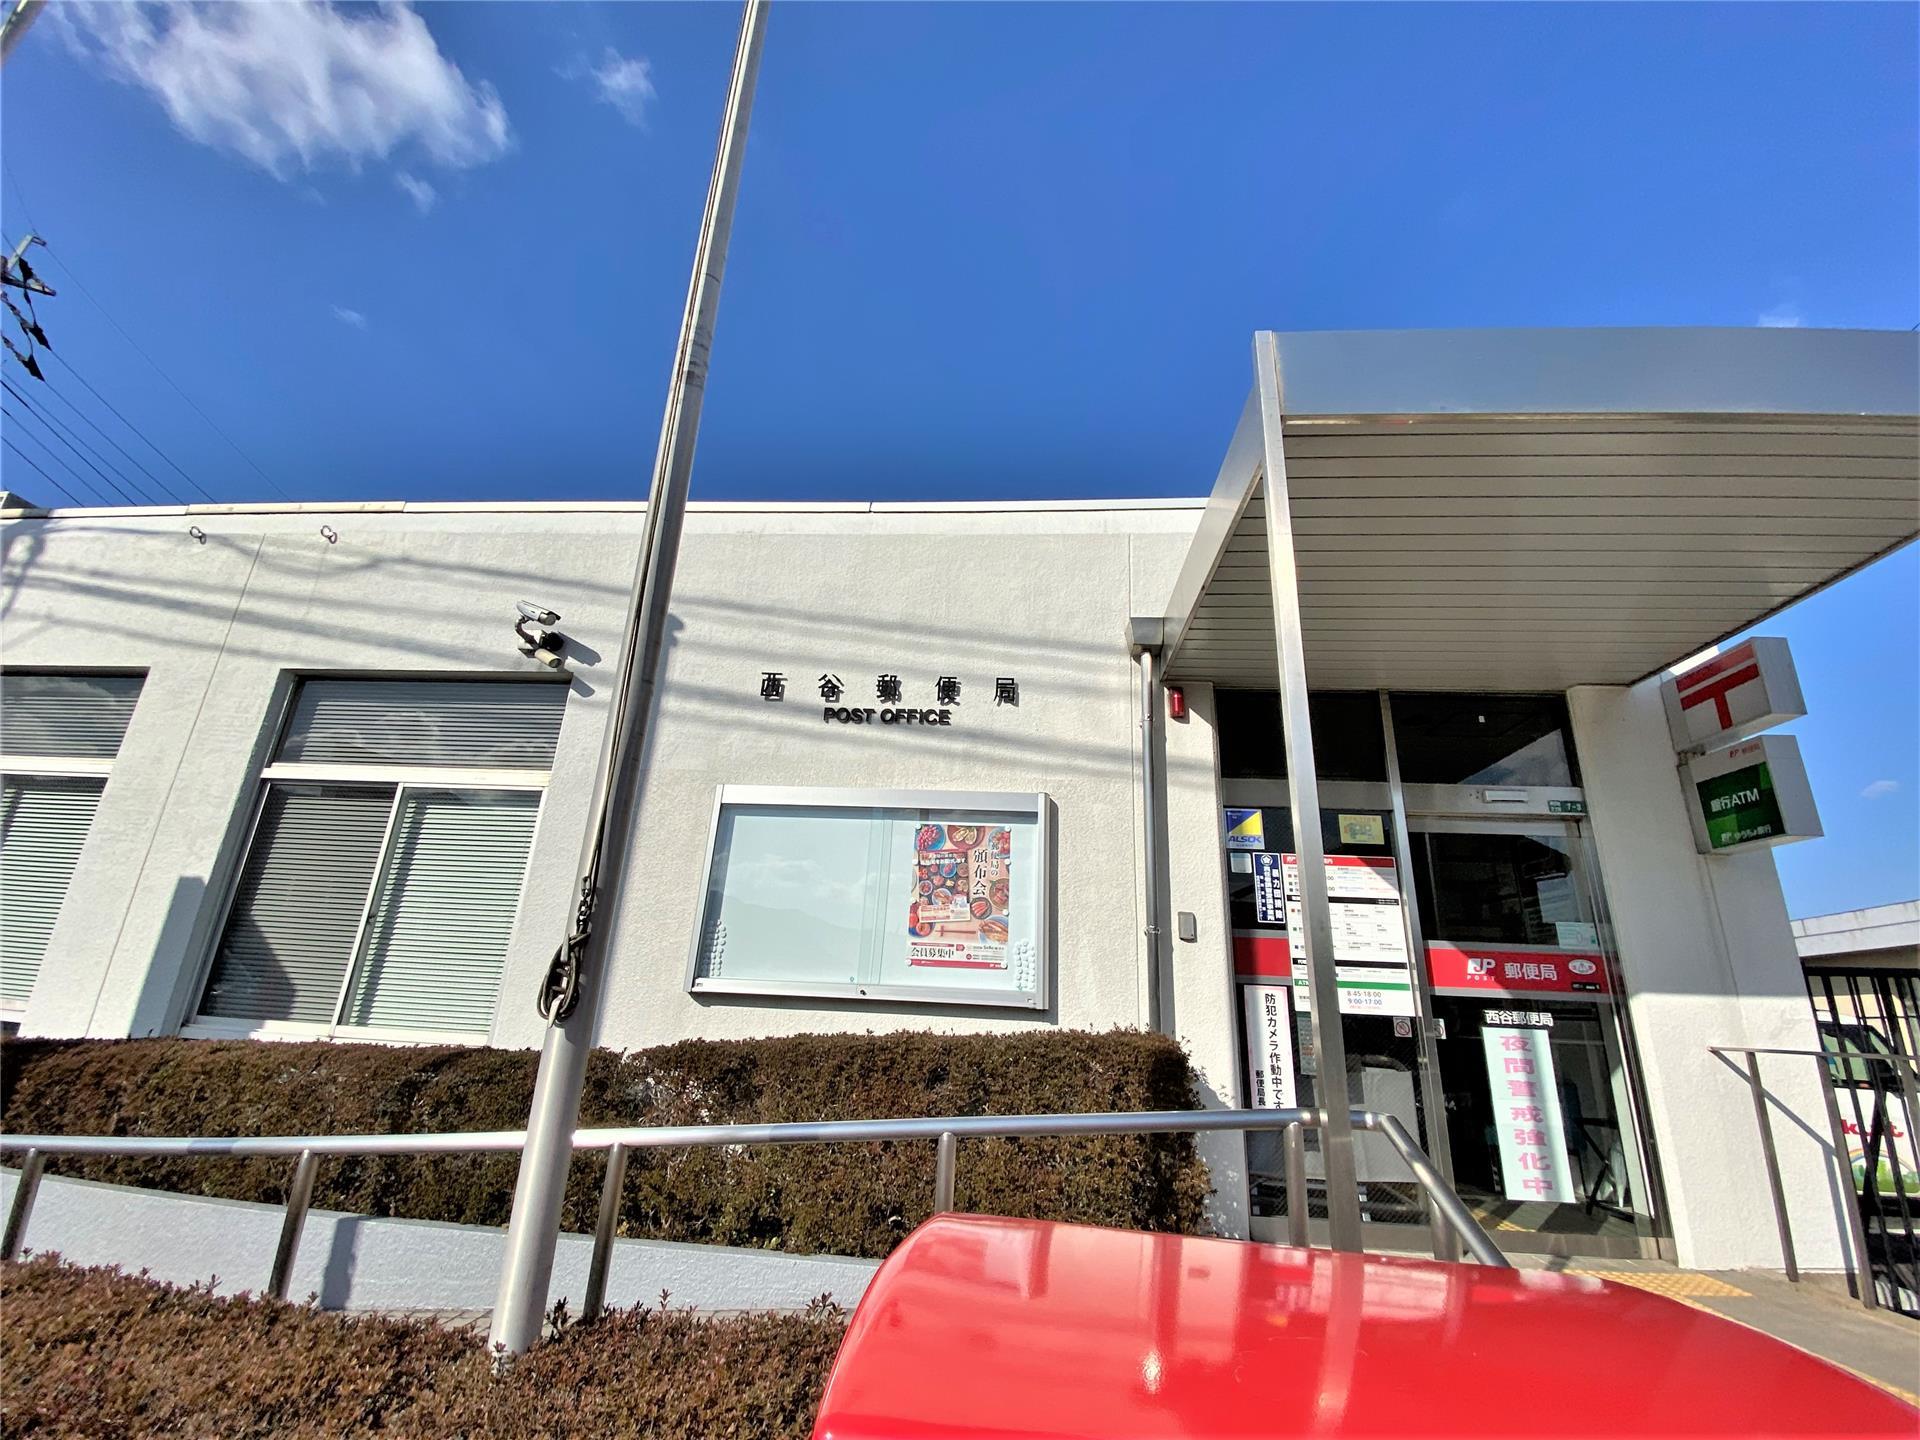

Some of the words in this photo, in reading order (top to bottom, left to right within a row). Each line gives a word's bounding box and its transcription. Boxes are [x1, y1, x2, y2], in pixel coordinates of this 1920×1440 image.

[760, 672, 1017, 705] 西谷郵便局
[823, 707, 876, 724] POST
[880, 709, 952, 726] OFFICE
[1710, 787, 1760, 812] 銀行ATM
[973, 849, 988, 896] 頒布会
[911, 947, 955, 959] 会員募集中
[1467, 958, 1496, 975] JP
[1504, 962, 1558, 981] 郵便局
[1484, 1009, 1554, 1027] 西谷郵便局
[1264, 993, 1284, 1109] 防犯カメラ作動中です
[1255, 1069, 1266, 1107] 郵便局長
[1499, 1035, 1553, 1195] 夜間警戒強化中
